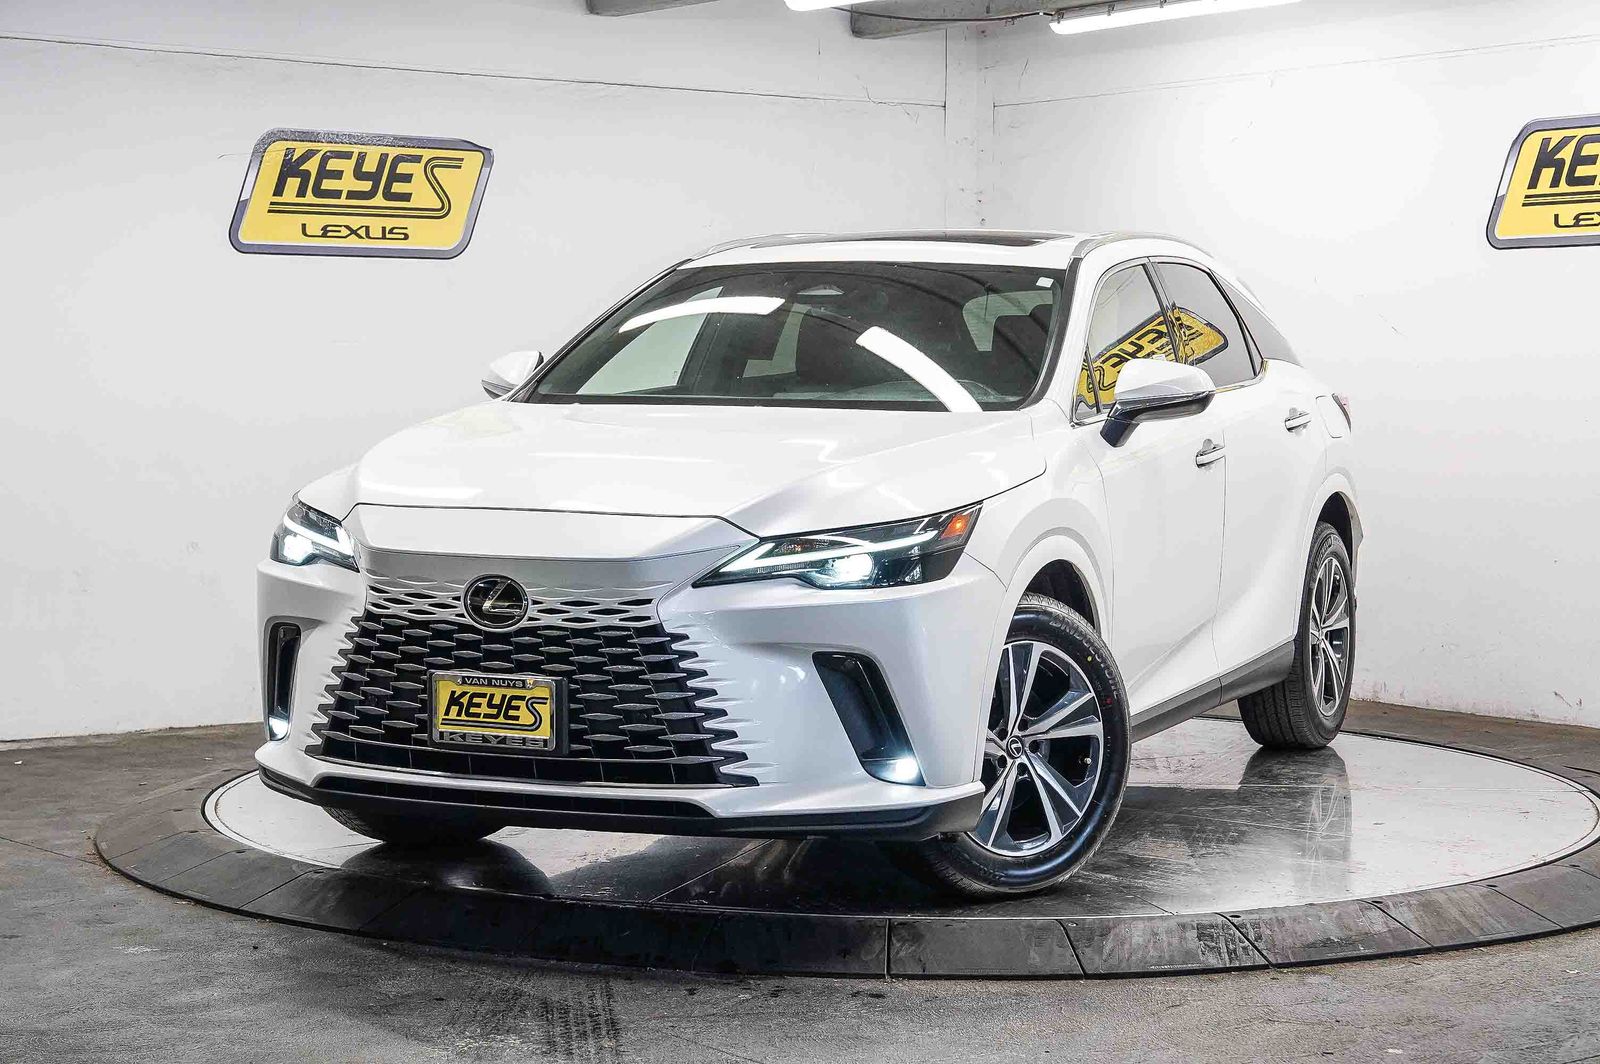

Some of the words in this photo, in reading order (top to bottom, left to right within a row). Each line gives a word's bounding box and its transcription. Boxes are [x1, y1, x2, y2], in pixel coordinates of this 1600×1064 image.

[1525, 133, 1600, 190] KE
[268, 147, 464, 219] KEYES
[1554, 211, 1600, 228] LE
[301, 223, 409, 241] LEXUS
[464, 677, 488, 686] VAN
[491, 678, 523, 688] NUYS
[440, 690, 549, 731] KEYES
[443, 732, 544, 748] KEYES
